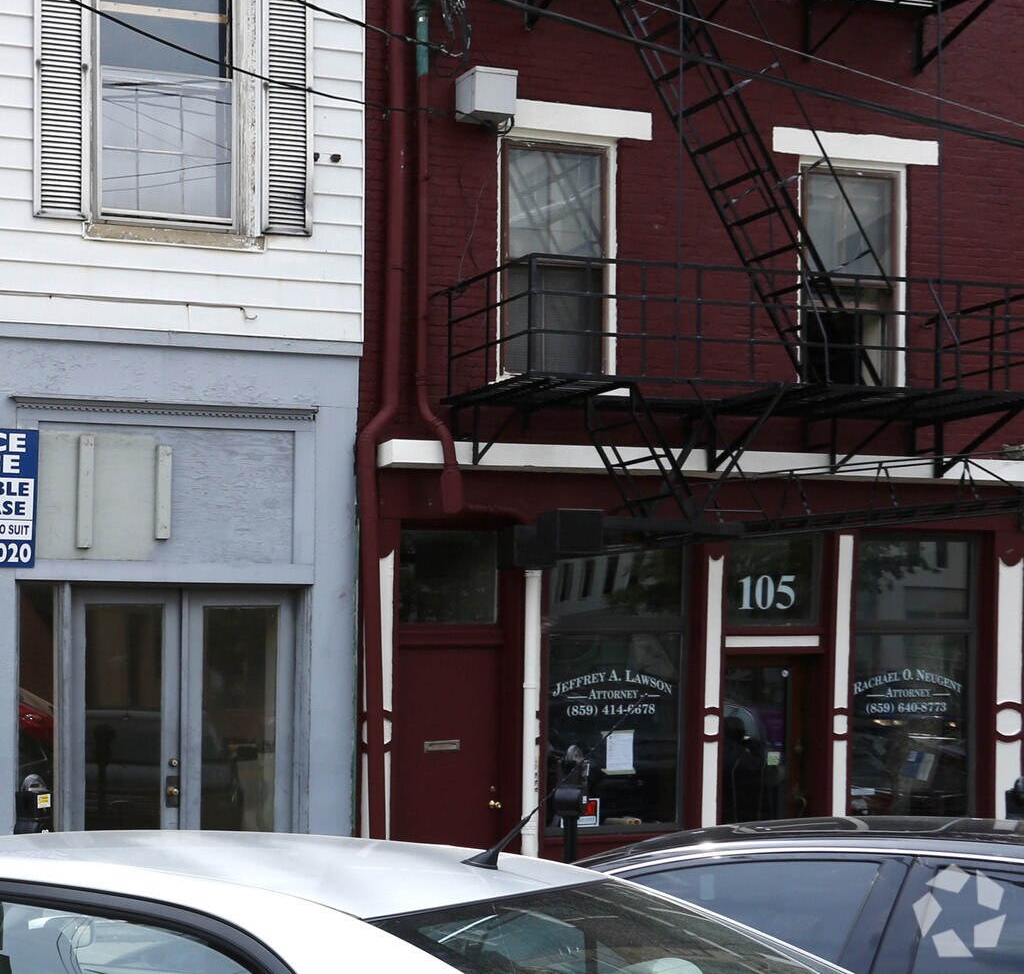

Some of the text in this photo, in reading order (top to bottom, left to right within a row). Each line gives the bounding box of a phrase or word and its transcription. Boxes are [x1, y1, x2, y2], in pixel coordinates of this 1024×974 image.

[8, 524, 30, 536] SUIT
[737, 574, 796, 610] 105
[552, 669, 673, 697] JEFFREY A. LAWSON
[853, 668, 963, 695] RACHAEL O. NEUGENT
[588, 688, 639, 700] ATTORNEY
[885, 687, 931, 698] ATTORNEY
[566, 705, 598, 717] (859)
[865, 702, 947, 714] (859) 640-8773
